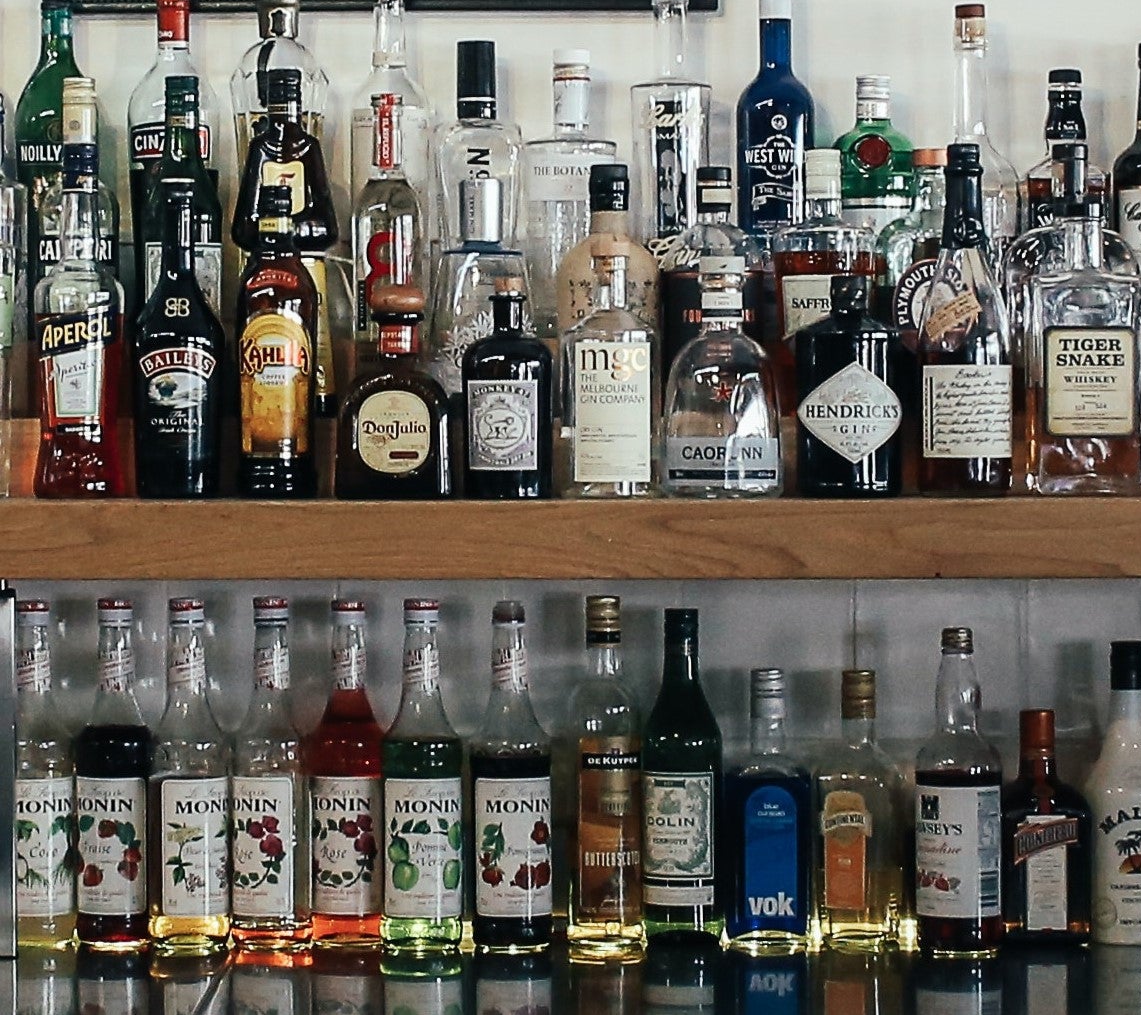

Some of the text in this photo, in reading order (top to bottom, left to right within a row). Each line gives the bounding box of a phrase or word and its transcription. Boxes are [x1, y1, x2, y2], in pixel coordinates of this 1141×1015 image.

[20, 144, 63, 162] NOILLY
[744, 148, 775, 164] WEST
[533, 166, 551, 176] THE
[41, 317, 112, 351] APEROL
[1058, 338, 1122, 352] TIGER
[143, 350, 213, 372] BAILEYS
[239, 337, 312, 376] KAHLA
[580, 346, 648, 382] mgc
[1055, 352, 1126, 367] SNAKE
[580, 373, 599, 383] THE
[1063, 375, 1118, 384] WHISKEY
[580, 384, 638, 395] MELBOURNE
[599, 394, 647, 405] COMPANY
[805, 404, 900, 420] HENDRICK'S
[394, 798, 460, 814] MONIN
[485, 798, 551, 814] MONIN
[647, 815, 696, 828] DOLIN
[748, 891, 795, 917] vok
